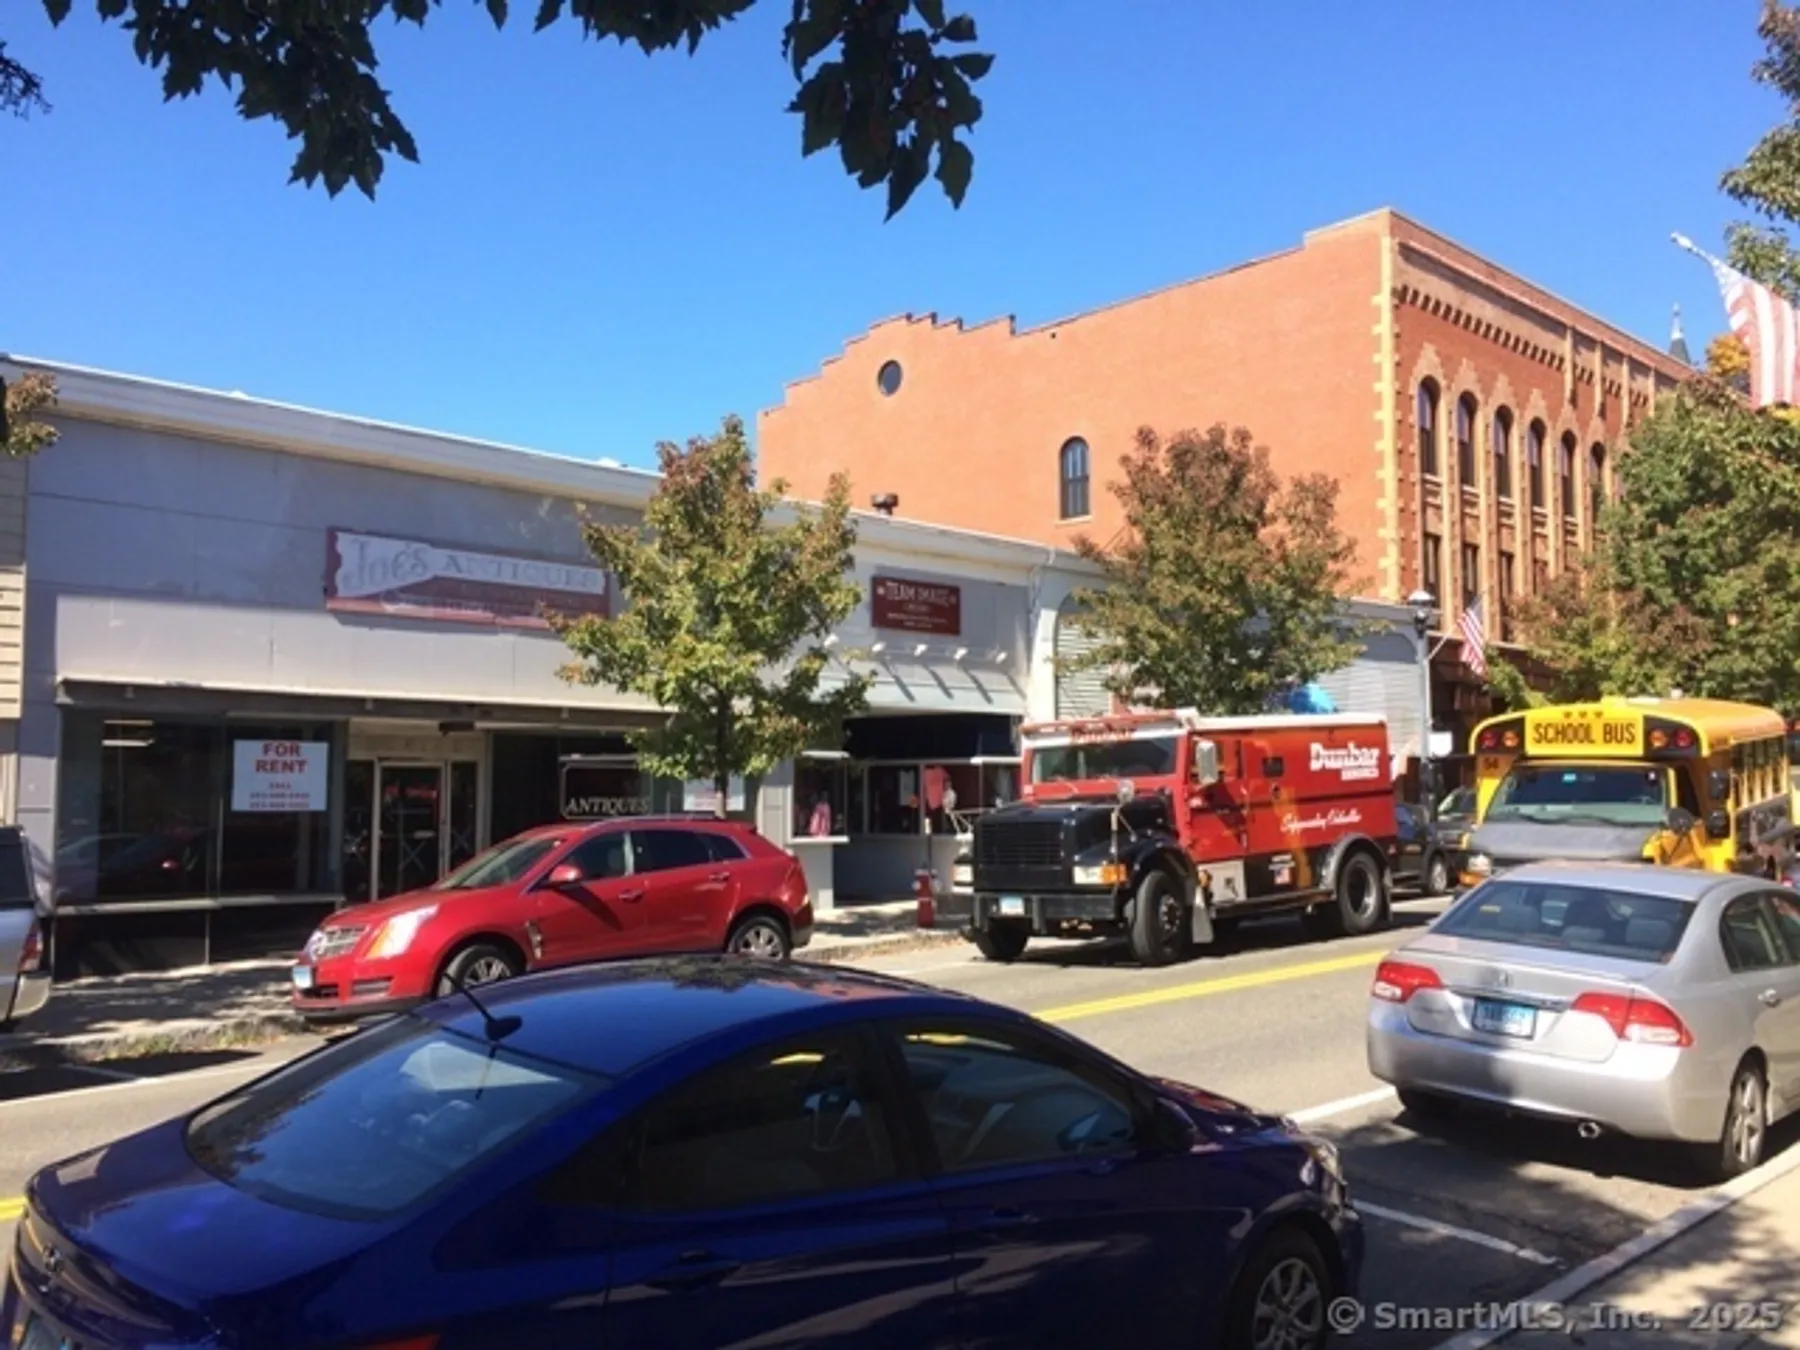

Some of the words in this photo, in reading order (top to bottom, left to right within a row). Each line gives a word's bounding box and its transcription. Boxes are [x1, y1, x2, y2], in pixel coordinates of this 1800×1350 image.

[1533, 723, 1596, 744] SCHOOL
[1603, 723, 1635, 744] BUS
[262, 742, 302, 758] FOR
[255, 759, 308, 774] RENT
[566, 797, 648, 817] ANTIQUES
